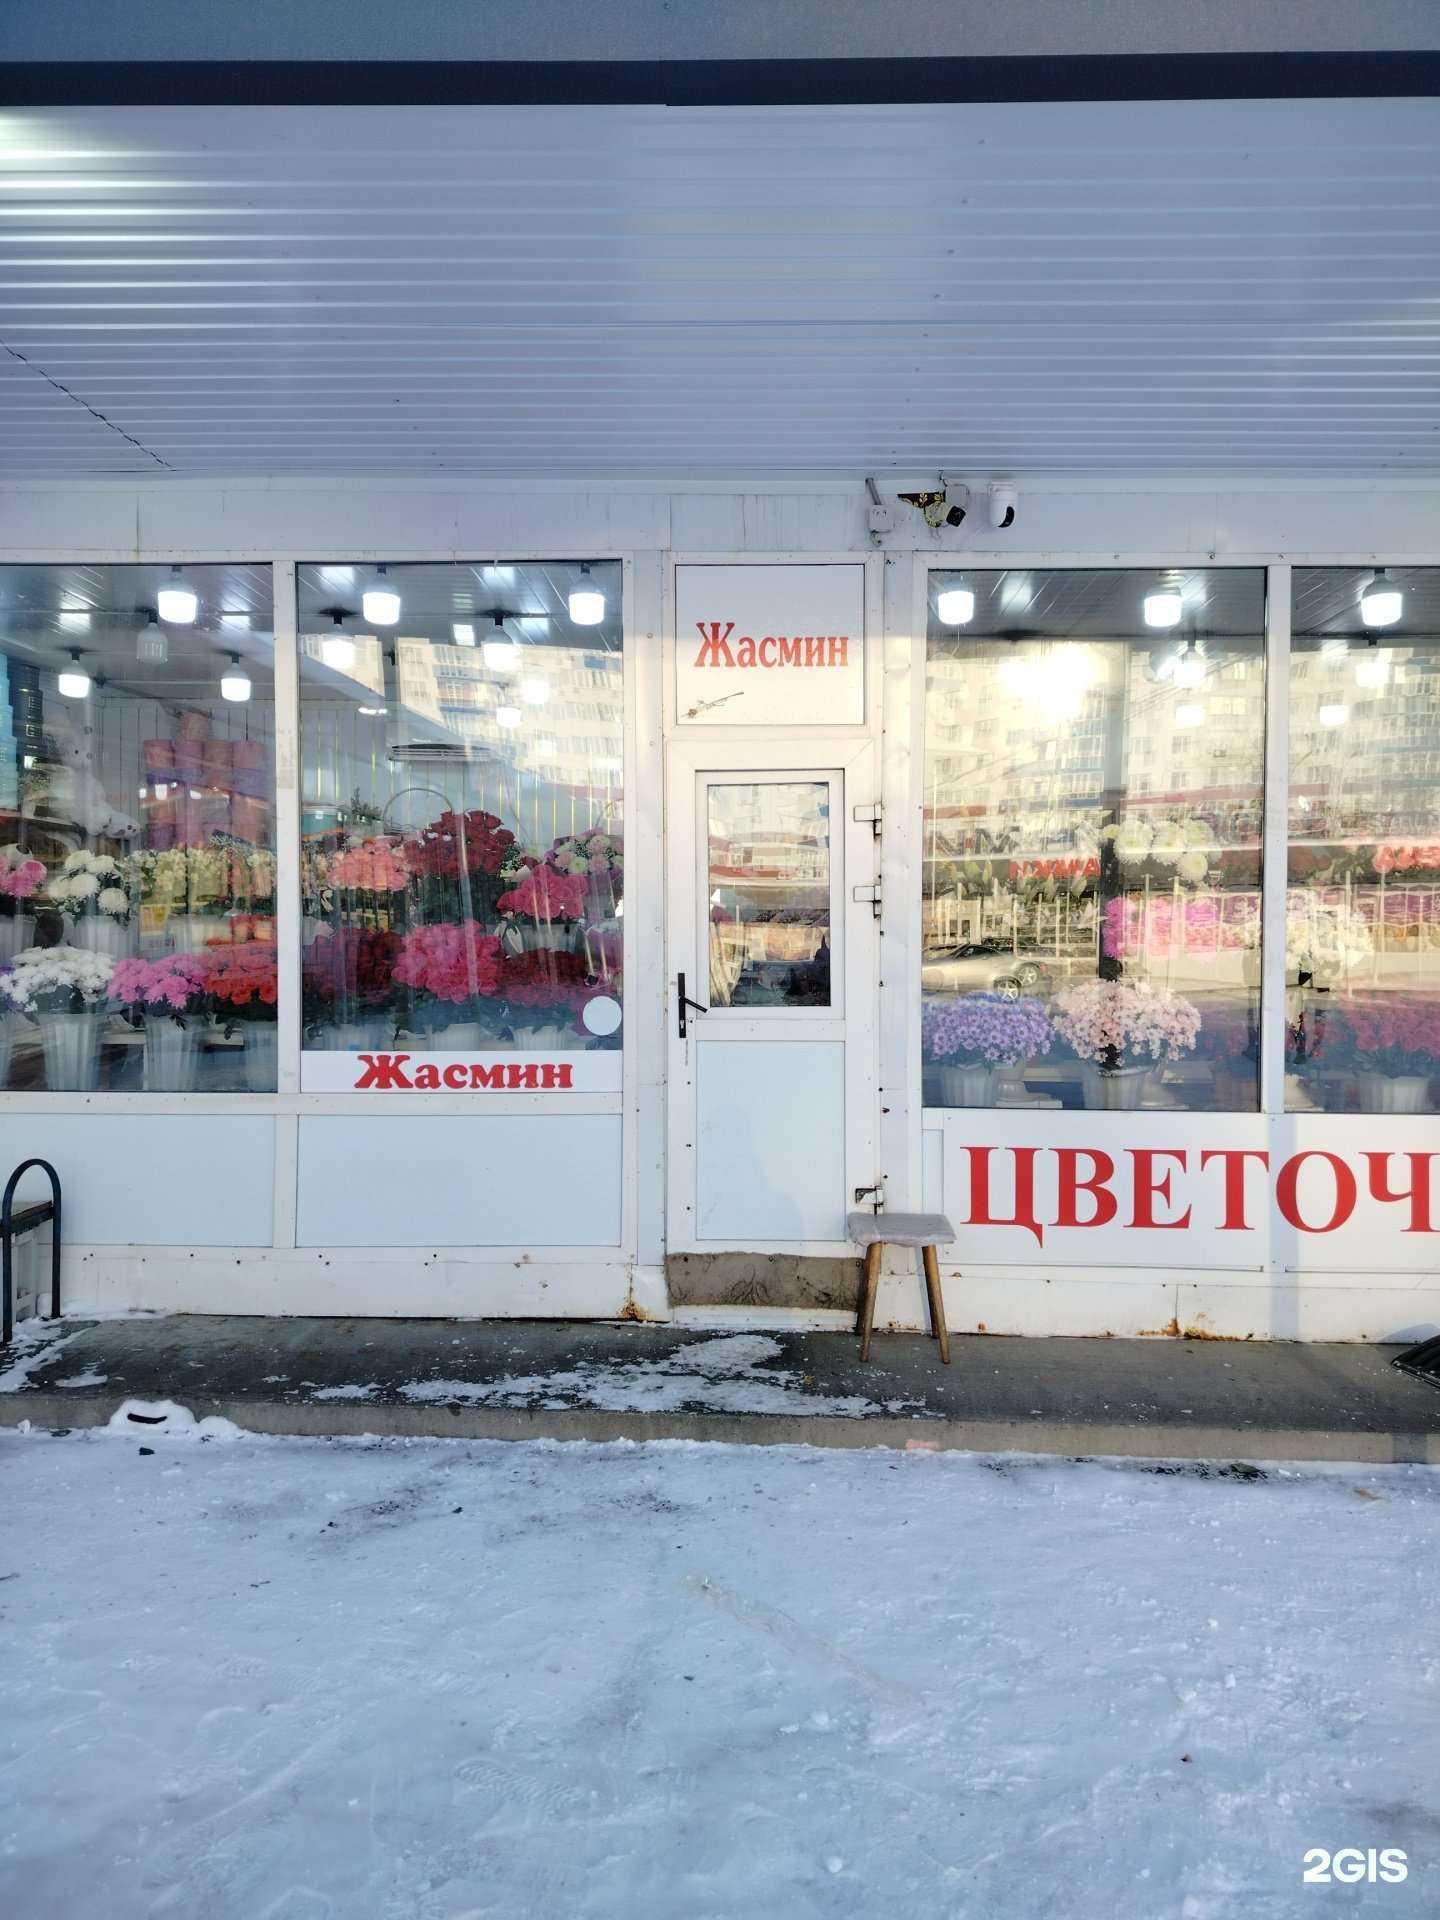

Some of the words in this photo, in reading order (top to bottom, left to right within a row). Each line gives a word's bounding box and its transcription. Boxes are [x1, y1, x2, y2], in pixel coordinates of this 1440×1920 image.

[694, 622, 849, 668] Жасмин
[354, 1055, 573, 1089] Жасмин
[960, 1146, 1440, 1248] ЦВЕТОЧ
